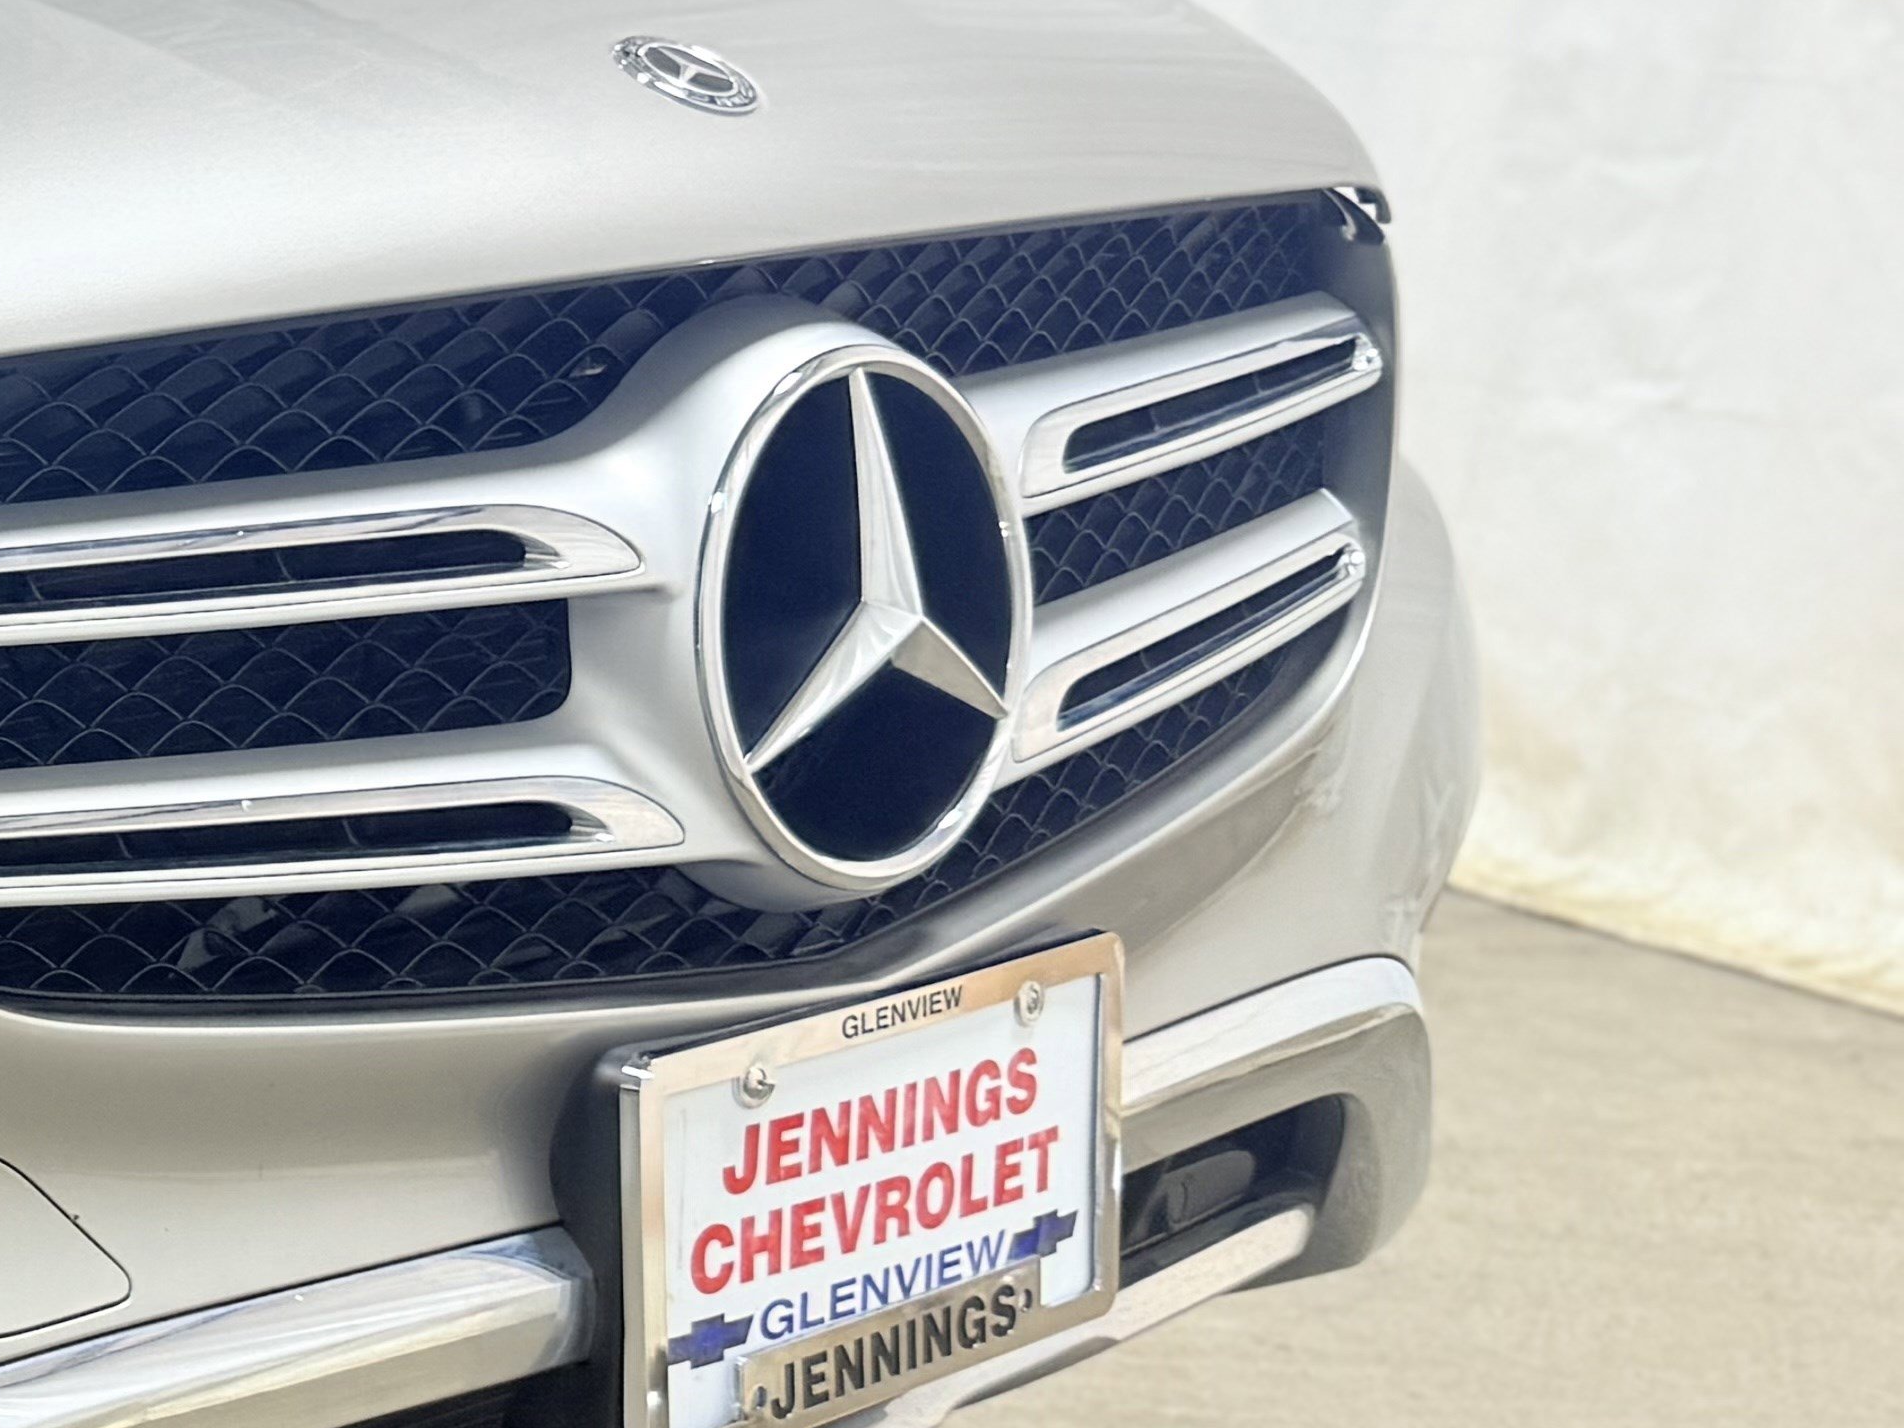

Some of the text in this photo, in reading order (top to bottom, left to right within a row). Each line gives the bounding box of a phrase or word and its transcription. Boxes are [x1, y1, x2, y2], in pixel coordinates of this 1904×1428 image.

[840, 985, 965, 1040] GLENVIEW
[722, 1047, 1038, 1196] JENNINGS
[690, 1126, 1060, 1296] CHEVROLET
[758, 1229, 1009, 1342] GLENVIEW
[769, 1282, 1019, 1421] JENNINGS
